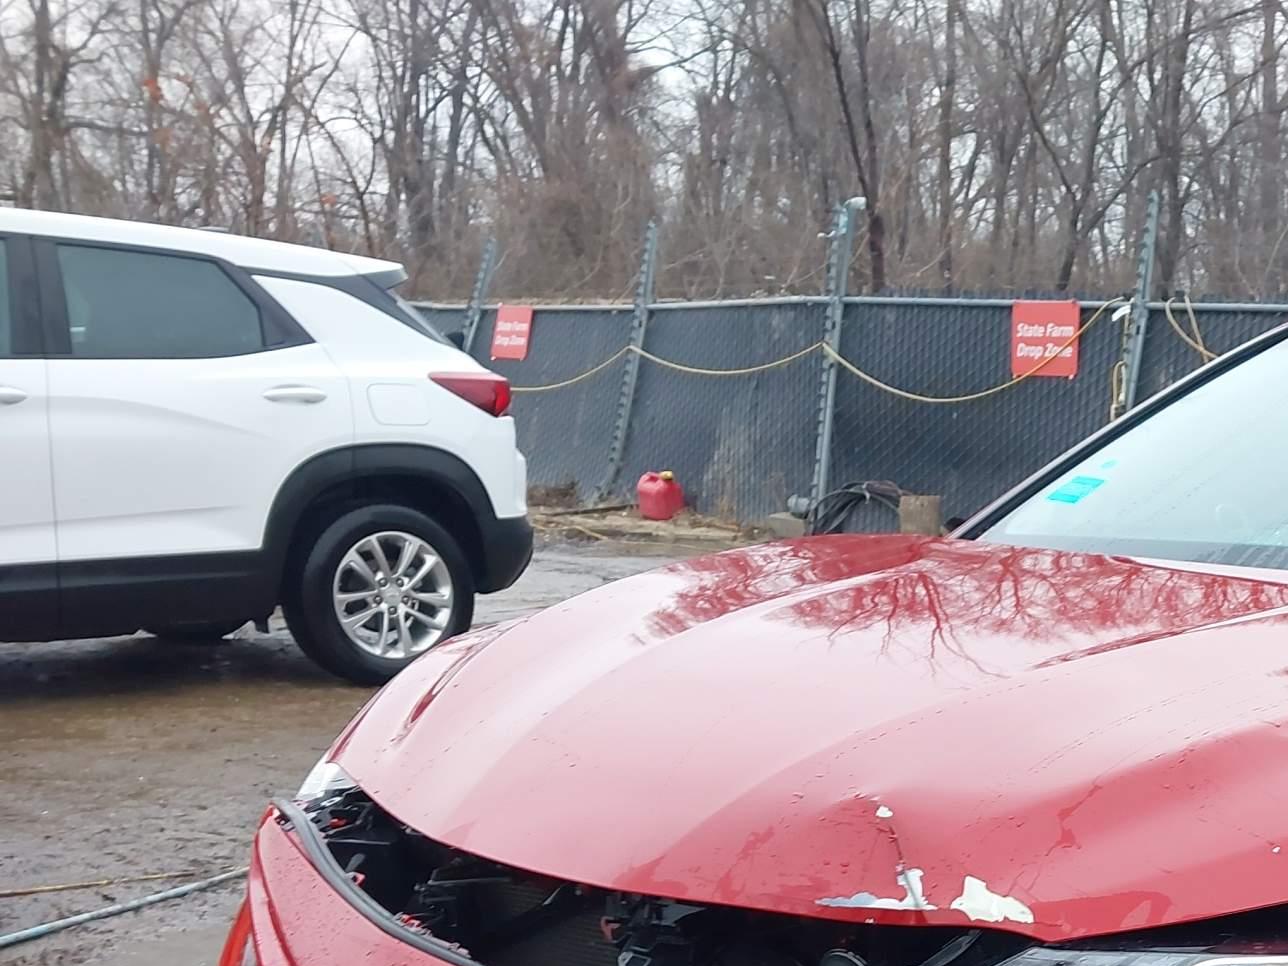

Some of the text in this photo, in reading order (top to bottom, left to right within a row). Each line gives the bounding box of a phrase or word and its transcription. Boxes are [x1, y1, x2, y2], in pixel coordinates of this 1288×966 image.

[1016, 323, 1074, 337] State Farm
[1016, 343, 1044, 360] Drop
